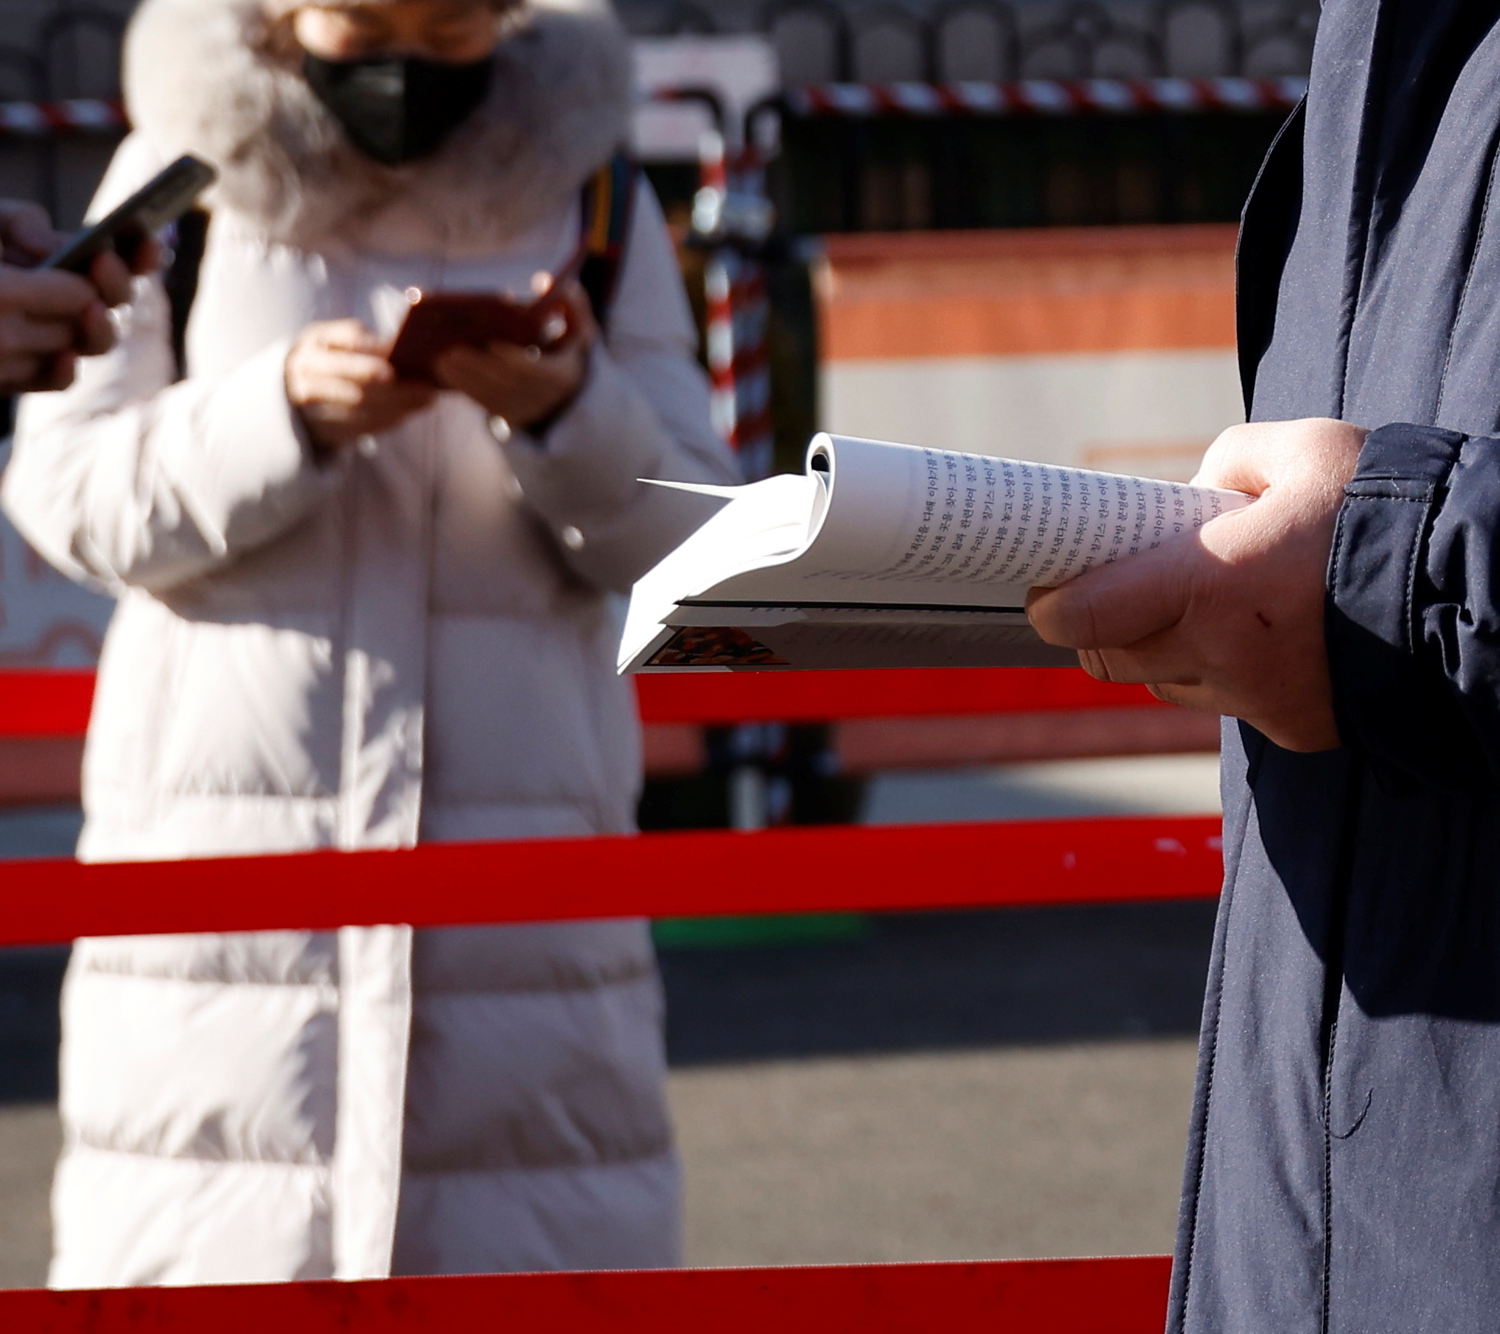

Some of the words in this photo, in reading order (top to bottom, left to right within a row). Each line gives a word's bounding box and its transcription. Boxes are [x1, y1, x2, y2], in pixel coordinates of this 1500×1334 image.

[927, 458, 938, 496] 이야기를
[949, 474, 956, 483] 그
[923, 500, 936, 521] 다해
[946, 488, 957, 508] 찾아
[961, 488, 976, 529] 관련하여
[1079, 483, 1090, 512] 사이의
[939, 512, 953, 532] 곳을
[1007, 527, 1027, 562] 대부분의
[1021, 482, 1034, 523] 유목민이
[1038, 496, 1052, 536] 대부분의
[1073, 516, 1089, 545] 유목민
[970, 527, 988, 553] 우리는
[1050, 518, 1069, 555] 보냈다고
[1112, 525, 1125, 545] 금방
